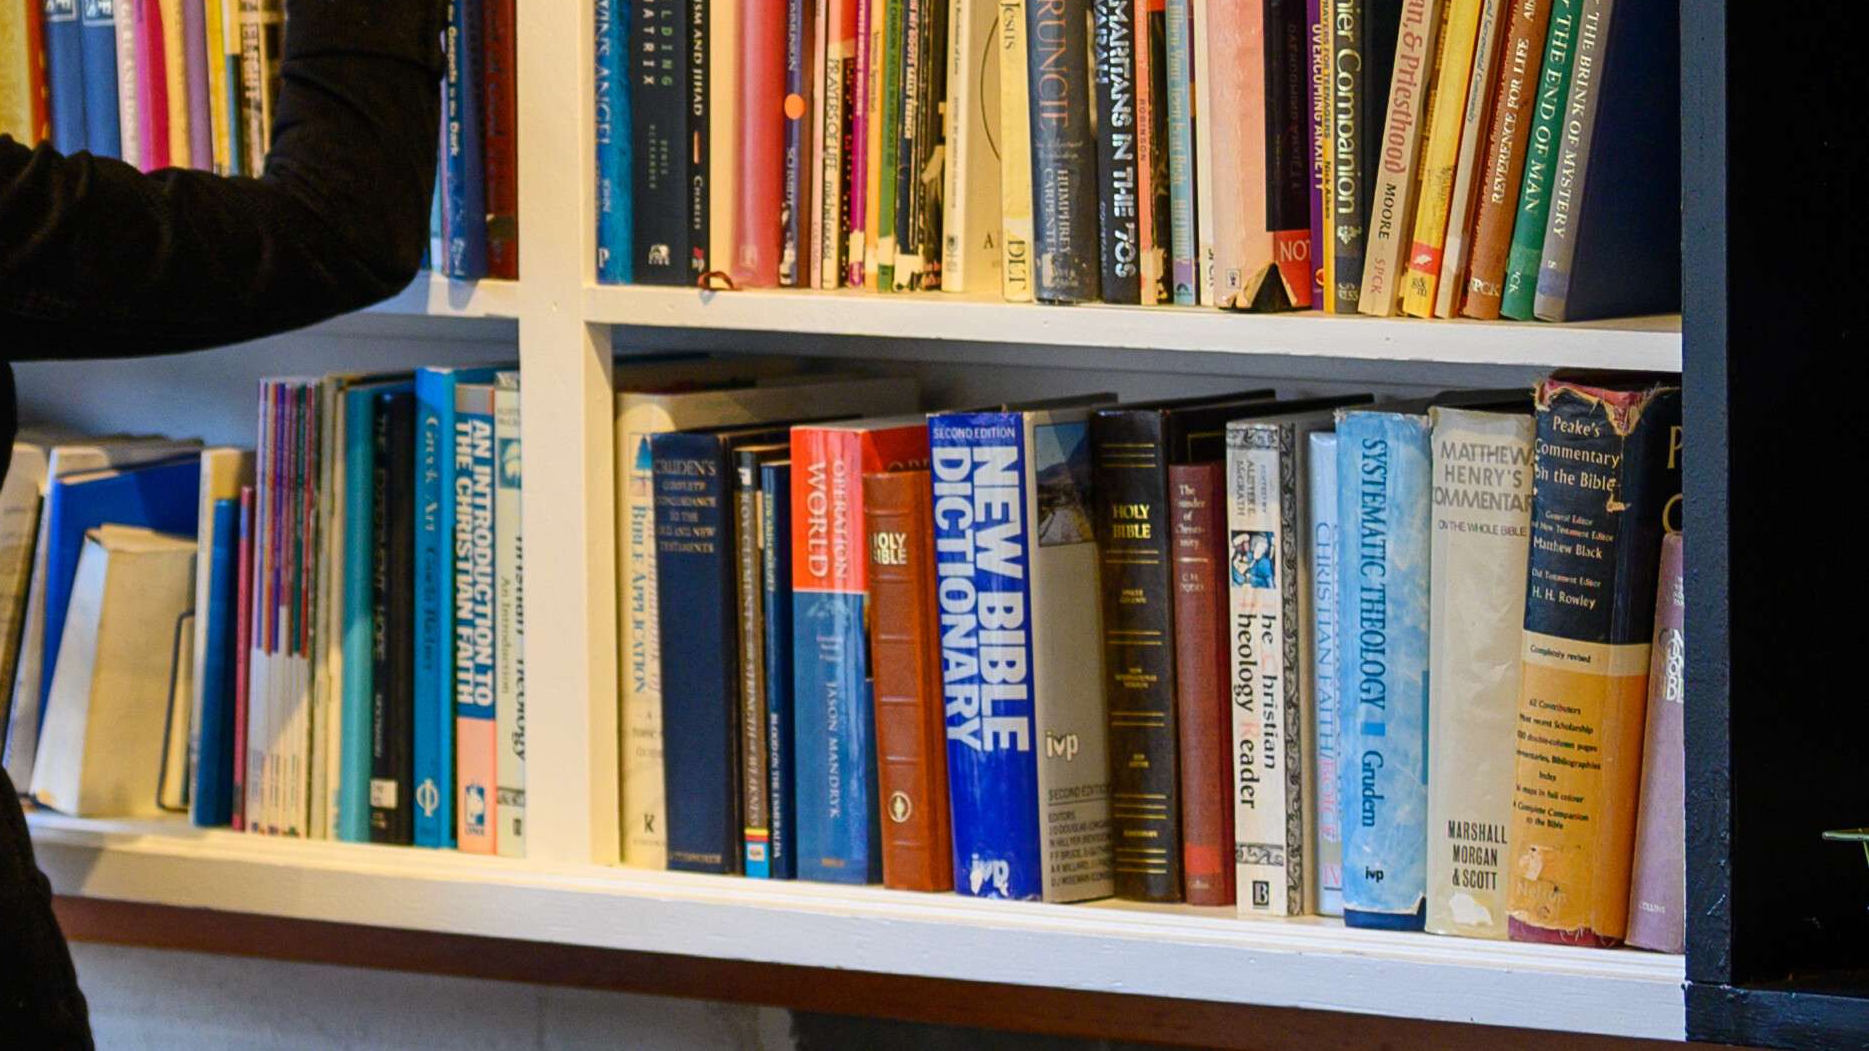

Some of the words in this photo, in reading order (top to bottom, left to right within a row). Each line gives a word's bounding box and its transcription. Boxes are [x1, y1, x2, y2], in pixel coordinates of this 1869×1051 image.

[692, 29, 704, 64] AND
[1402, 31, 1422, 53] &
[1549, 14, 1574, 62] THE
[692, 67, 704, 116] JIHAD
[1383, 55, 1421, 174] Priesthood
[1539, 68, 1564, 120] END
[1112, 133, 1133, 160] IN
[1336, 48, 1361, 223] Companion
[1534, 125, 1552, 156] OF
[1113, 167, 1135, 217] THE
[1378, 182, 1397, 240] MOORE
[1523, 160, 1545, 213] MAN
[455, 420, 474, 470] THE
[473, 419, 492, 465] AN
[933, 426, 972, 440] SECOND
[974, 426, 1016, 439] EDITION
[1552, 415, 1602, 439] Peake's
[1441, 440, 1528, 466] MATTHEW
[1444, 467, 1523, 488] HENRY'S
[1534, 437, 1620, 468] Commentary
[1553, 466, 1576, 486] the
[1580, 470, 1618, 492] Bible
[807, 460, 828, 578] WORLD
[833, 459, 847, 578] OPERATION
[972, 445, 1024, 579] NEW
[1113, 504, 1150, 521] HOLY
[1113, 523, 1151, 540] BIBLE
[1359, 437, 1387, 577] SYSTEMATIC
[455, 476, 474, 621] CHRISTIAN
[632, 505, 647, 561] BIBLE
[1532, 535, 1573, 556] Matthew
[1575, 544, 1603, 560] Black
[472, 468, 493, 649] INTRODUCTION
[931, 447, 982, 751] DICTIONARY
[1532, 586, 1543, 600] H.
[1544, 588, 1556, 602] H.
[1558, 590, 1597, 611] Rowley
[632, 569, 647, 693] APPLICATION
[1359, 582, 1387, 711] THEOLOGY
[456, 624, 475, 705] FAITH
[473, 653, 494, 707] TO
[976, 591, 1030, 751] BIBLE
[826, 681, 840, 731] JASON
[827, 736, 841, 819] MANDRYK
[1361, 749, 1384, 826] Grudem
[1447, 819, 1508, 846] MARSHALL
[1452, 846, 1498, 867] MORGAN
[1364, 866, 1384, 883] ivp
[1451, 868, 1460, 886] &
[1461, 869, 1498, 890] SCOTT
